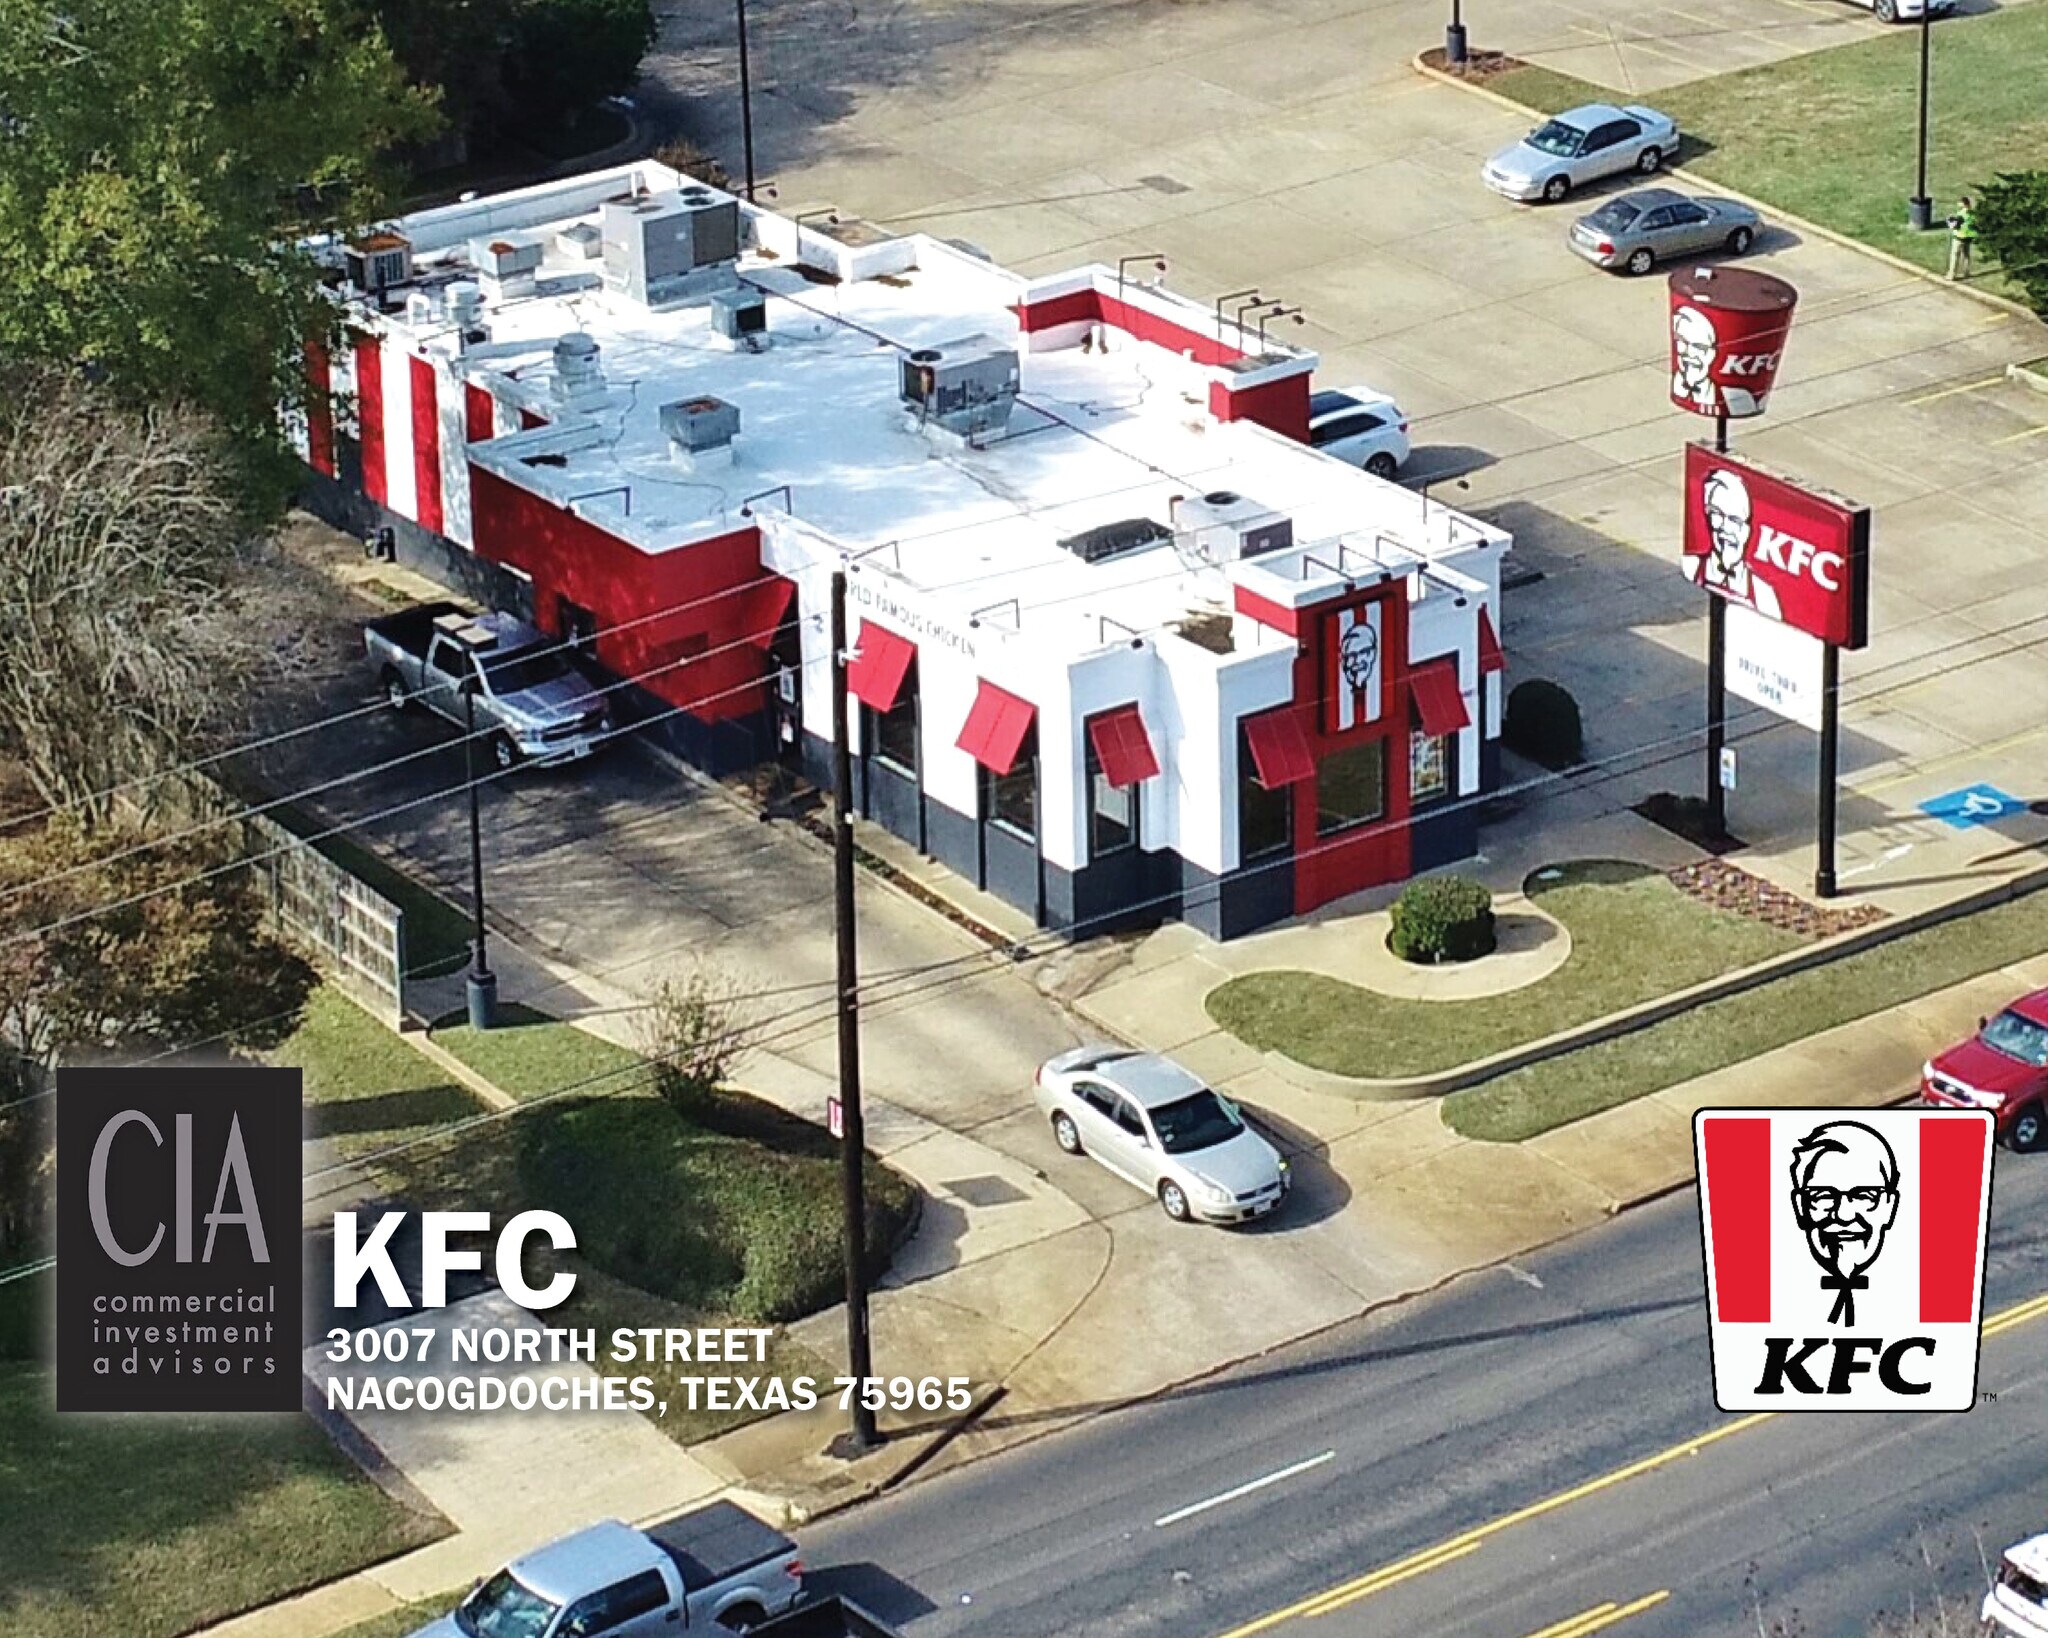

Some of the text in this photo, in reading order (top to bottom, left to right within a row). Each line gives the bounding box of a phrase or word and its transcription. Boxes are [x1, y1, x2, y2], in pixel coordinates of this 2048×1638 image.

[1719, 353, 1778, 375] KFC
[1754, 524, 1844, 591] KFC
[876, 593, 922, 632] FAMOUS
[926, 620, 976, 658] CHICKEN
